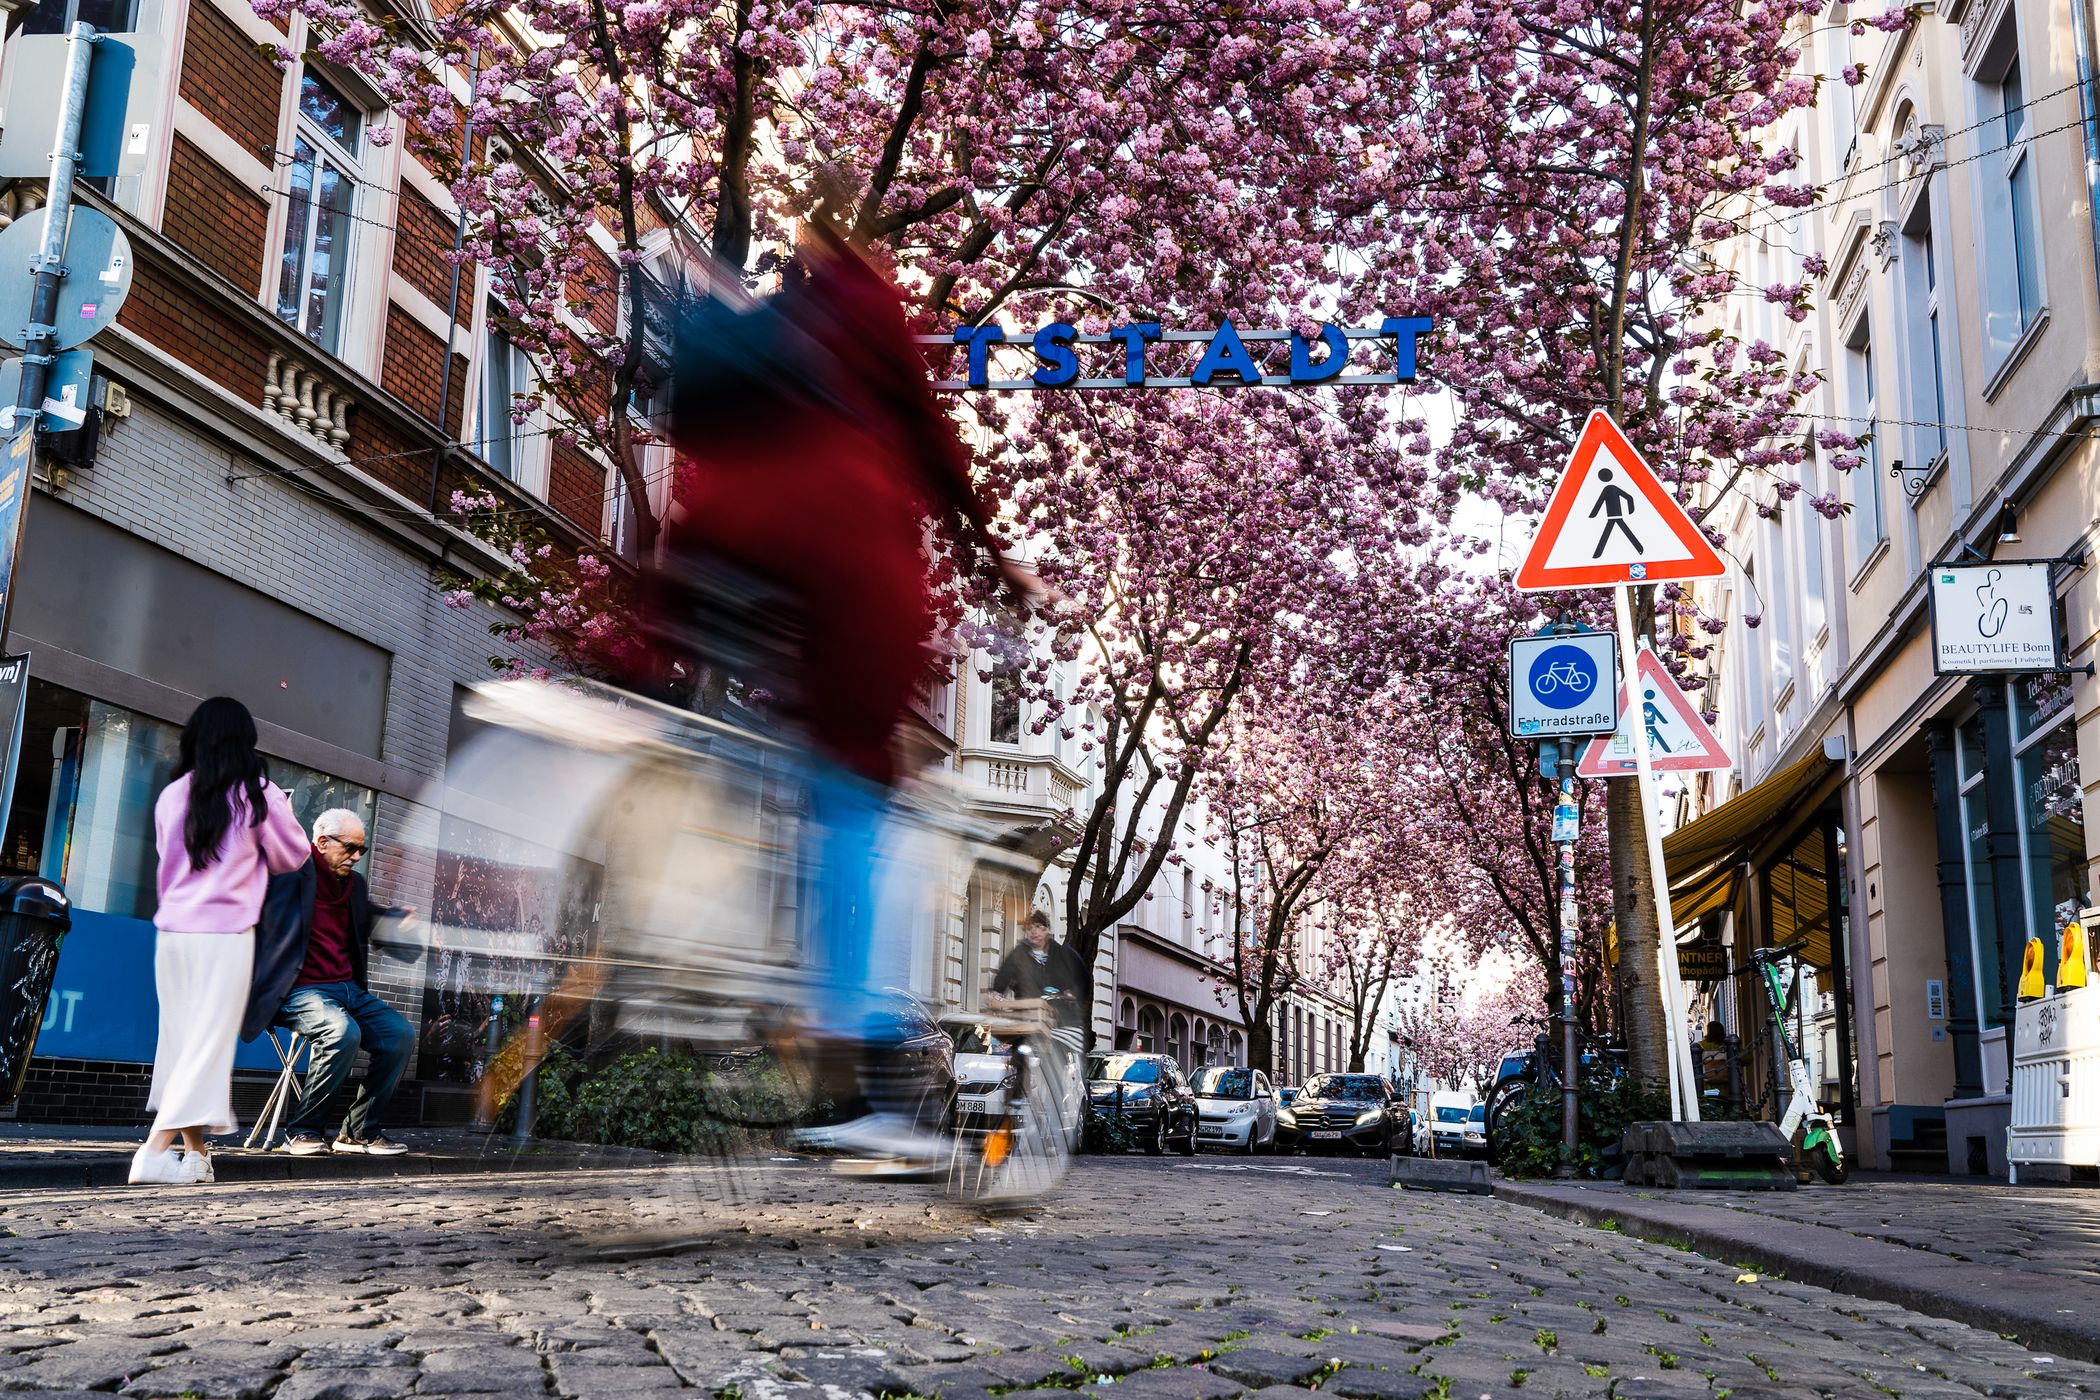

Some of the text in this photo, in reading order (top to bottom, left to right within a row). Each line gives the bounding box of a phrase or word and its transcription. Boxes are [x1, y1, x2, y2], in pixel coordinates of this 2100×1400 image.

[1941, 642, 2050, 655] BEAUTYLIFE Bonn
[967, 1102, 984, 1112] 888
